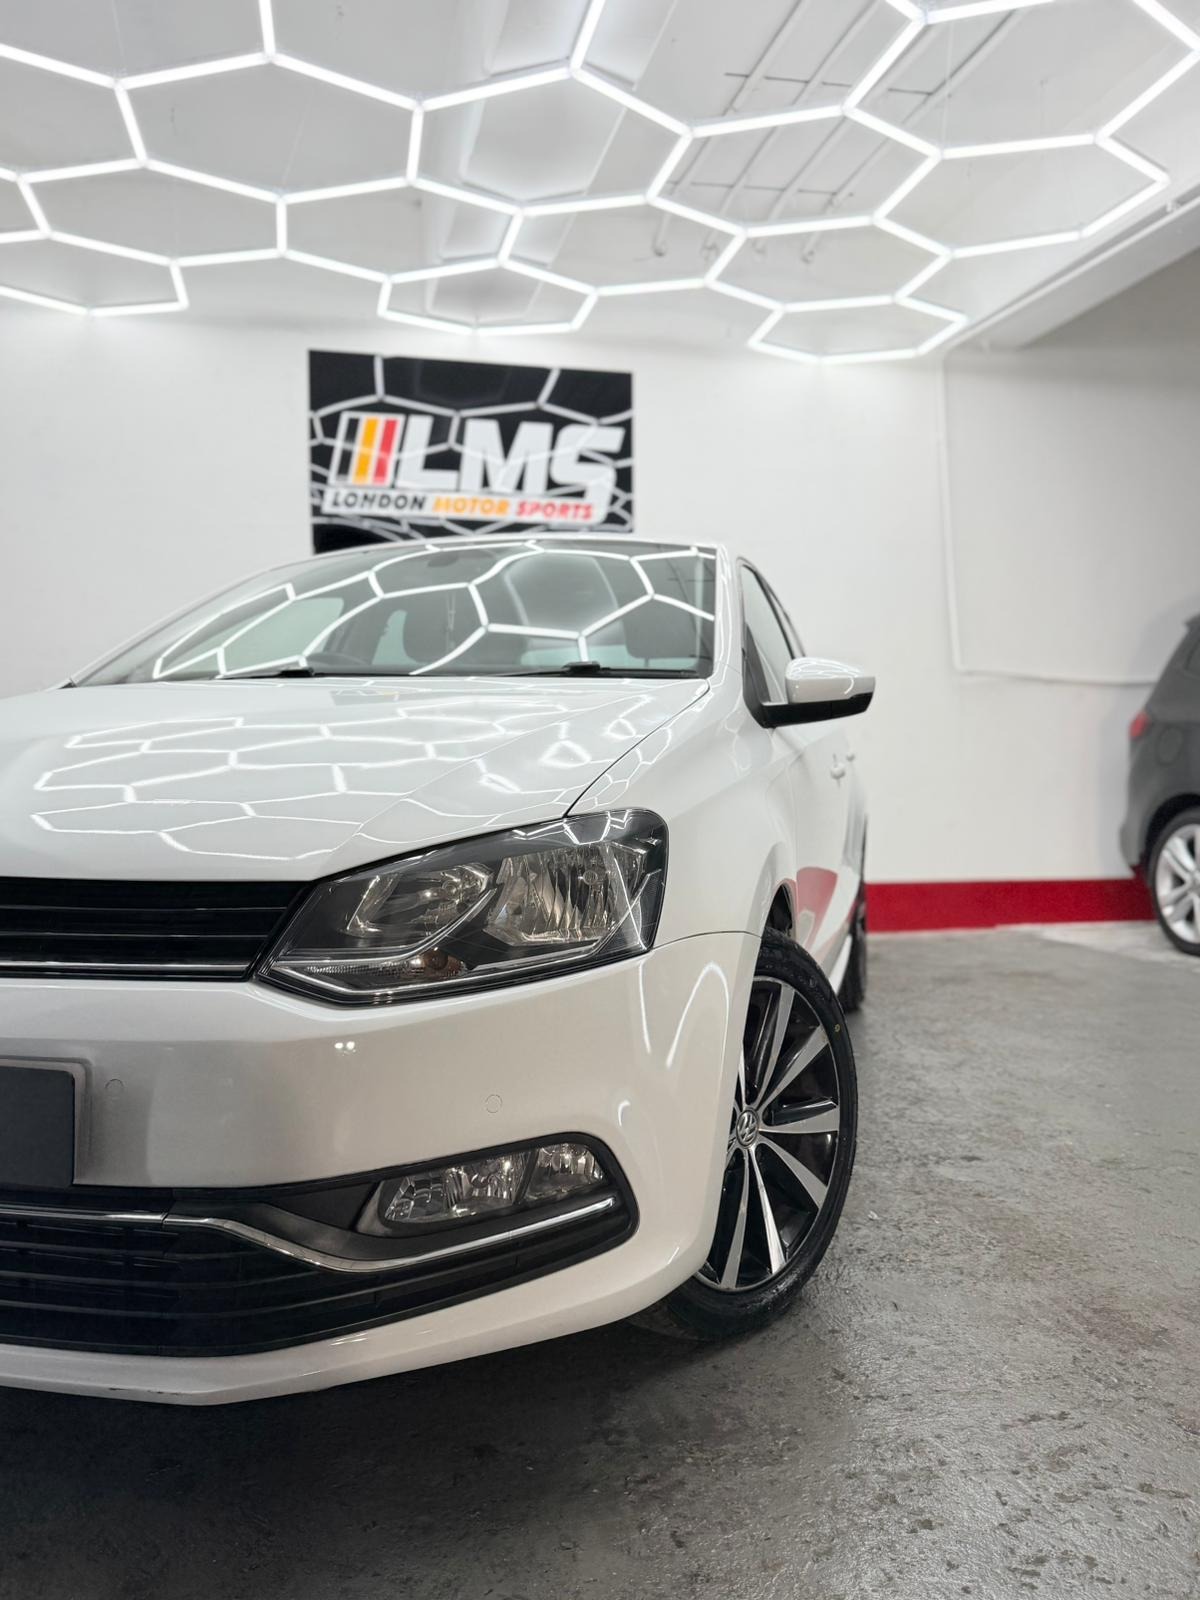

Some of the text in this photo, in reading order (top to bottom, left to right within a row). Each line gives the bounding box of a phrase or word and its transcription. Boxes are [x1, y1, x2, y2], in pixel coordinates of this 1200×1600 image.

[395, 413, 626, 511] LMS
[331, 491, 595, 520] LONDON MOTOR SPORTS
